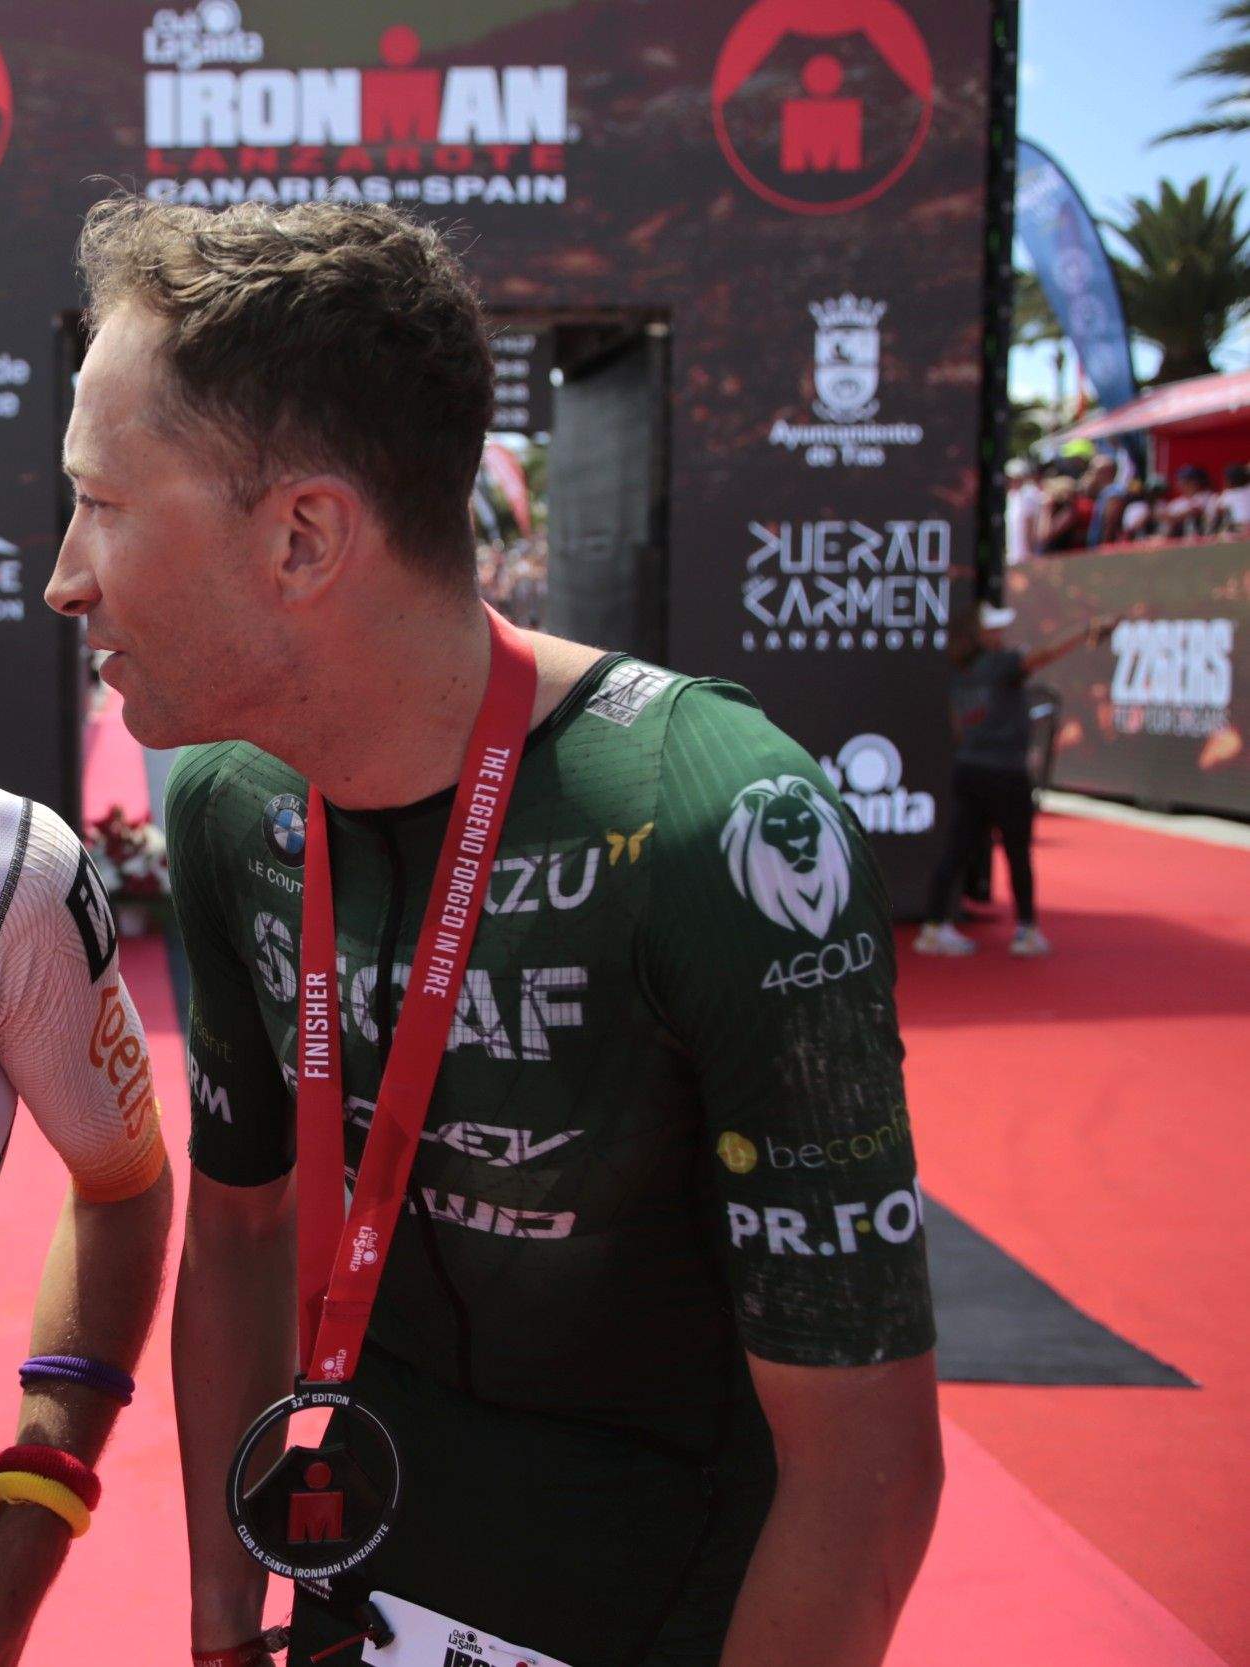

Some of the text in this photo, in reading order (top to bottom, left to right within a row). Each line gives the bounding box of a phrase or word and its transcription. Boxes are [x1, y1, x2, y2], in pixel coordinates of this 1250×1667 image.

[145, 60, 568, 148] IRONMAN
[145, 145, 566, 176] LANZAROTE
[146, 175, 391, 206] CANARIAS
[419, 174, 567, 205] SPAIN
[743, 575, 950, 628] CARMEN
[247, 857, 264, 878] LE
[423, 746, 510, 999] THE LEGEND FORGED IN FIRE
[761, 932, 876, 994] 4GOLD
[302, 970, 330, 1081] FINISHER
[366, 1231, 378, 1249] Club
[727, 1176, 924, 1257] PR.FO
[311, 1393, 350, 1406] EDITION
[237, 1522, 390, 1579] CLUB LA SANTA IRONMAN LANZAROTE
[453, 1629, 466, 1640] Club
